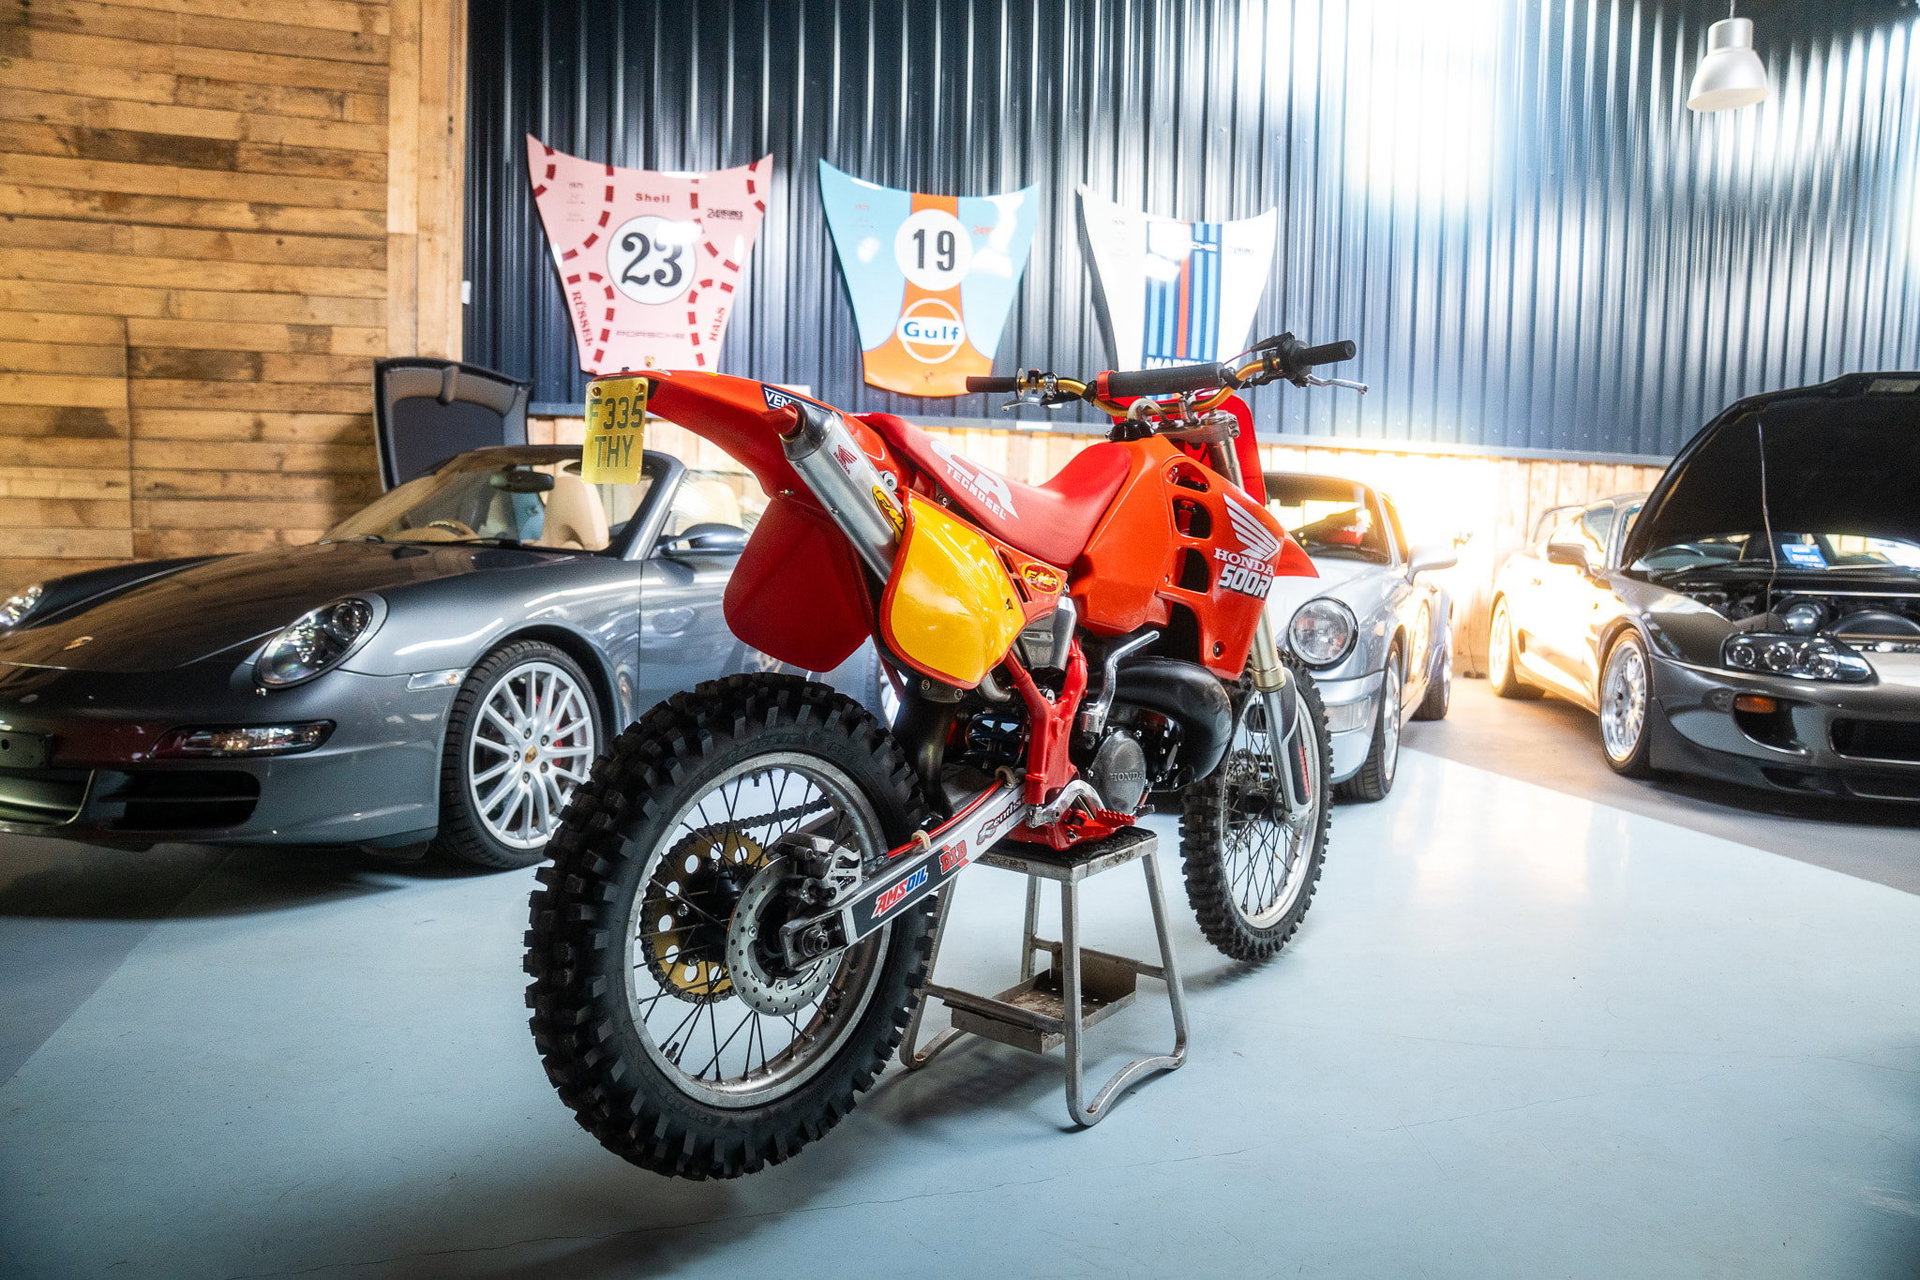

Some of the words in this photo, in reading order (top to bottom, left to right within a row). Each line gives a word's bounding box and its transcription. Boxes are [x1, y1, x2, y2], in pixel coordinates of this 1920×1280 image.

[635, 192, 670, 203] Shell
[621, 232, 683, 287] 23
[912, 228, 956, 272] 19
[903, 320, 959, 340] Gulf
[589, 395, 645, 430] F335
[595, 434, 634, 468] THY
[1213, 547, 1275, 577] HONDA
[1218, 564, 1273, 600] 500R
[1111, 772, 1144, 782] HONDA
[871, 865, 928, 919] AMSOIL
